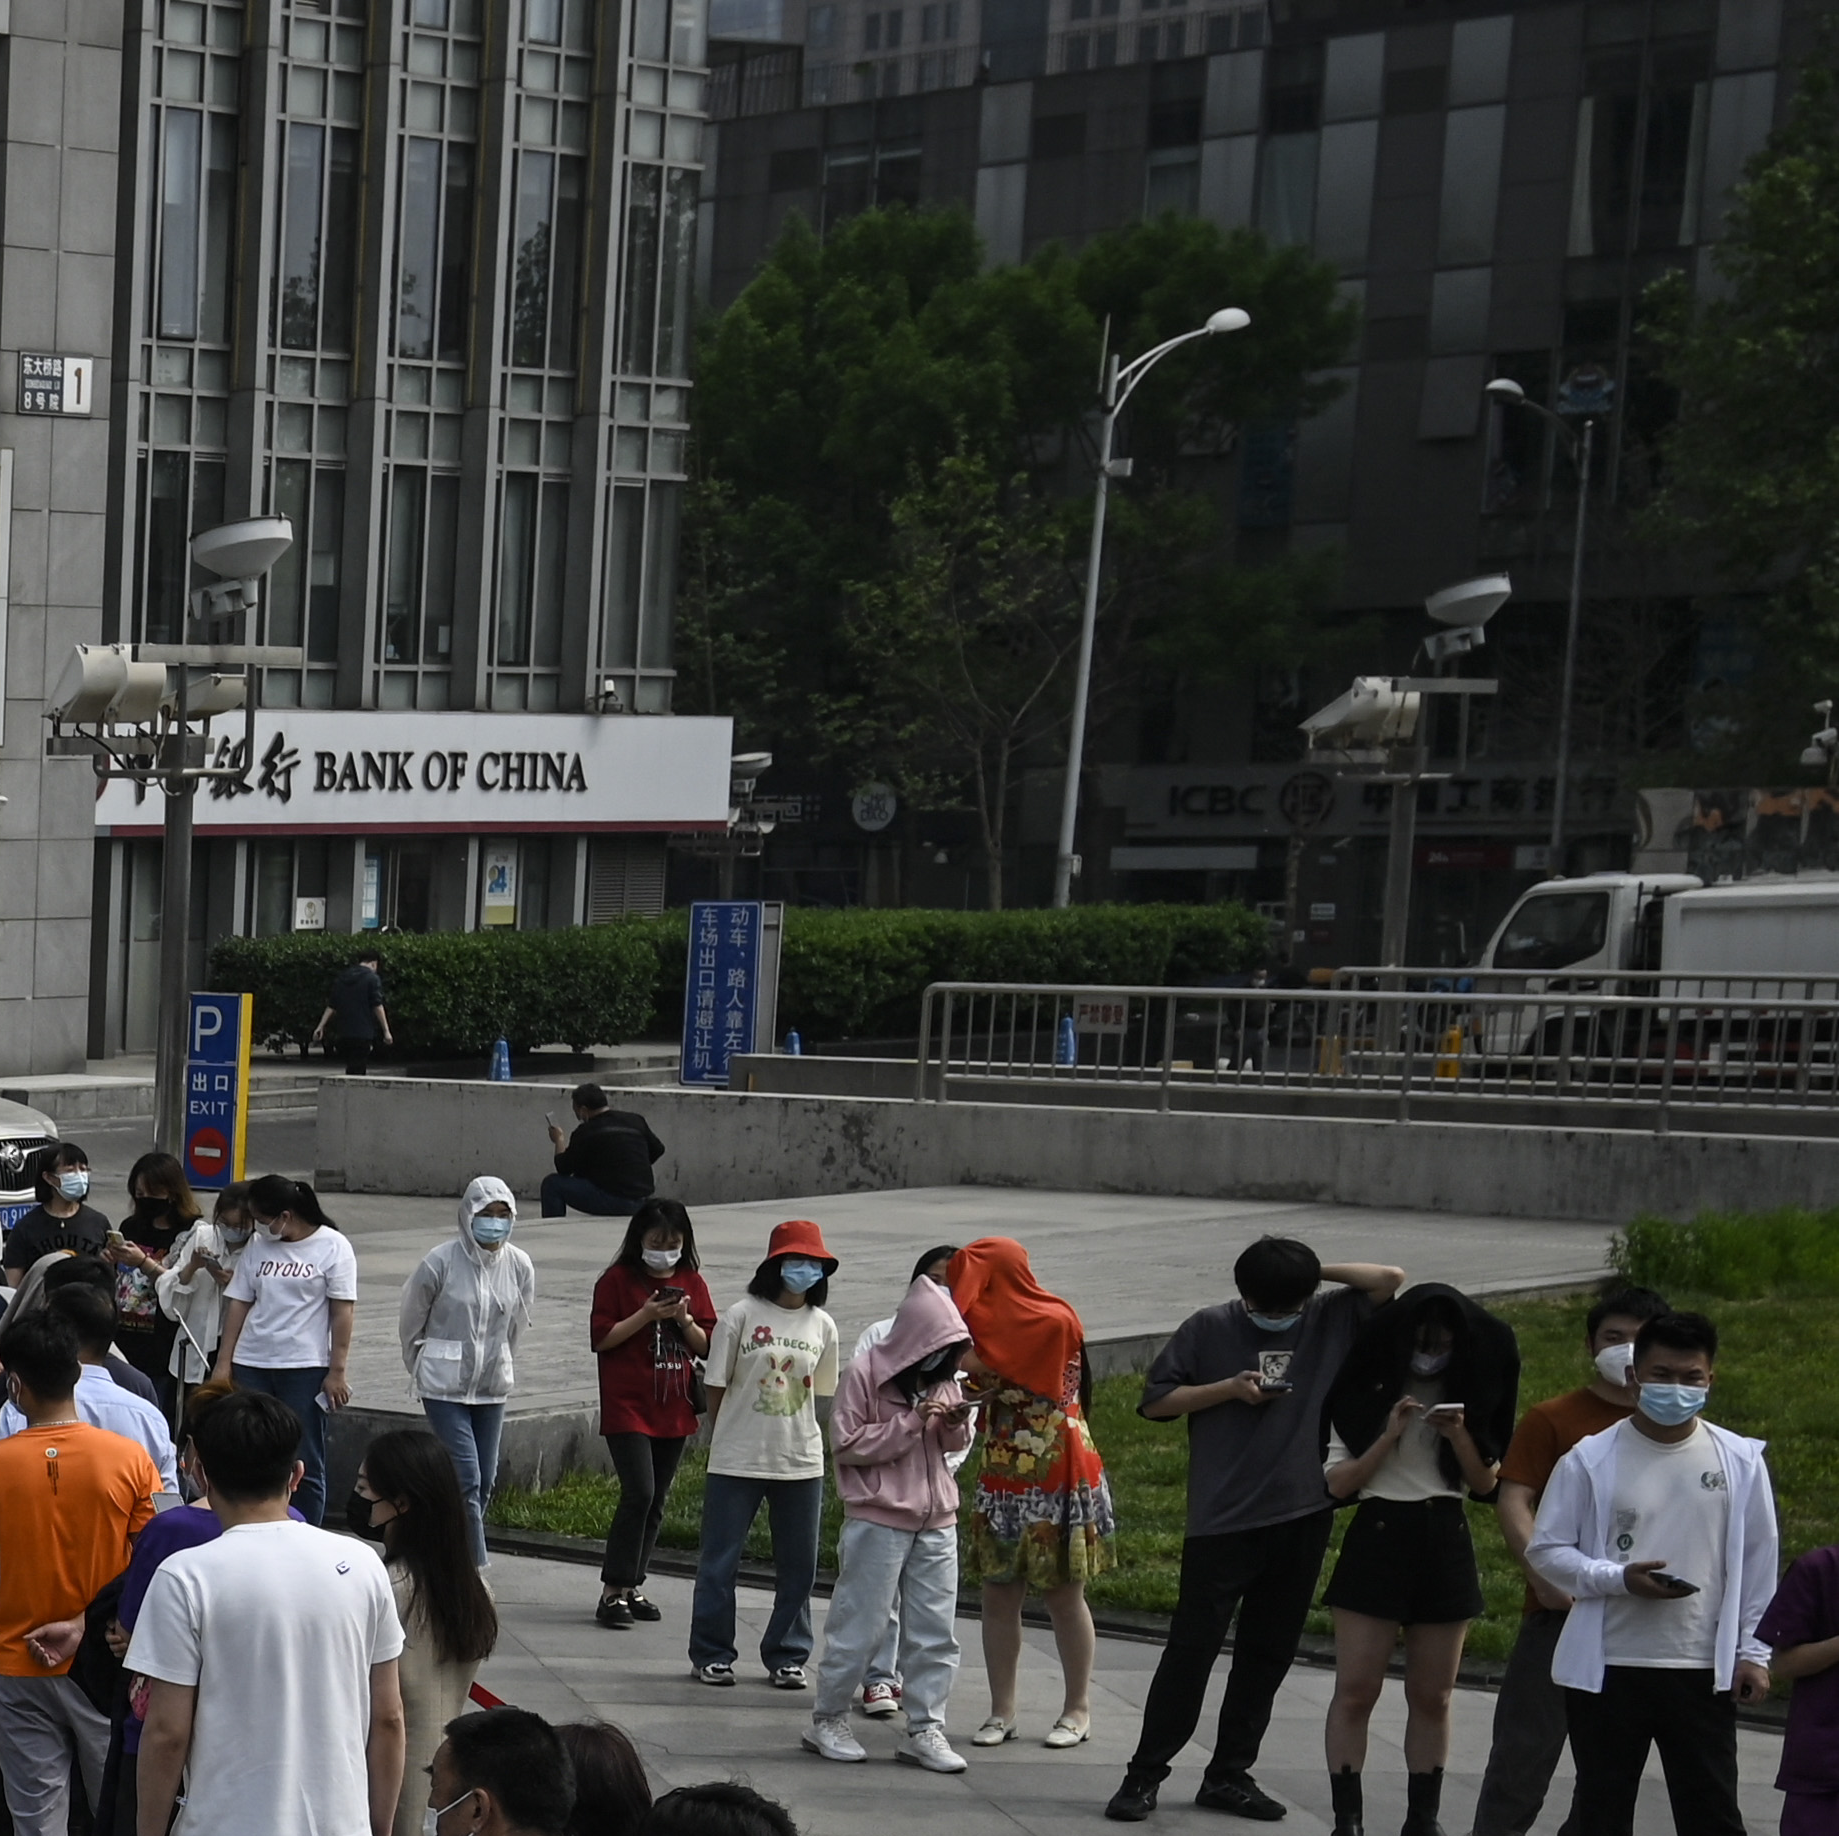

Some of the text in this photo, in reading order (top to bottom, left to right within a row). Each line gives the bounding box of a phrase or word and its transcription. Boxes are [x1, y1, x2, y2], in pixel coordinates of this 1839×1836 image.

[23, 356, 63, 378] 东大桥路
[74, 366, 82, 405] 1
[23, 391, 60, 411] 8号院
[312, 749, 413, 794] BANK
[421, 749, 468, 793] OF
[476, 750, 588, 794] CHINA
[1168, 783, 1269, 818] ICBC
[691, 906, 720, 1071] 车场出口请避让机
[193, 1002, 223, 1053] P
[191, 1072, 230, 1095] 出口
[189, 1098, 229, 1119] EXIT
[255, 1260, 314, 1279] JOYOUS
